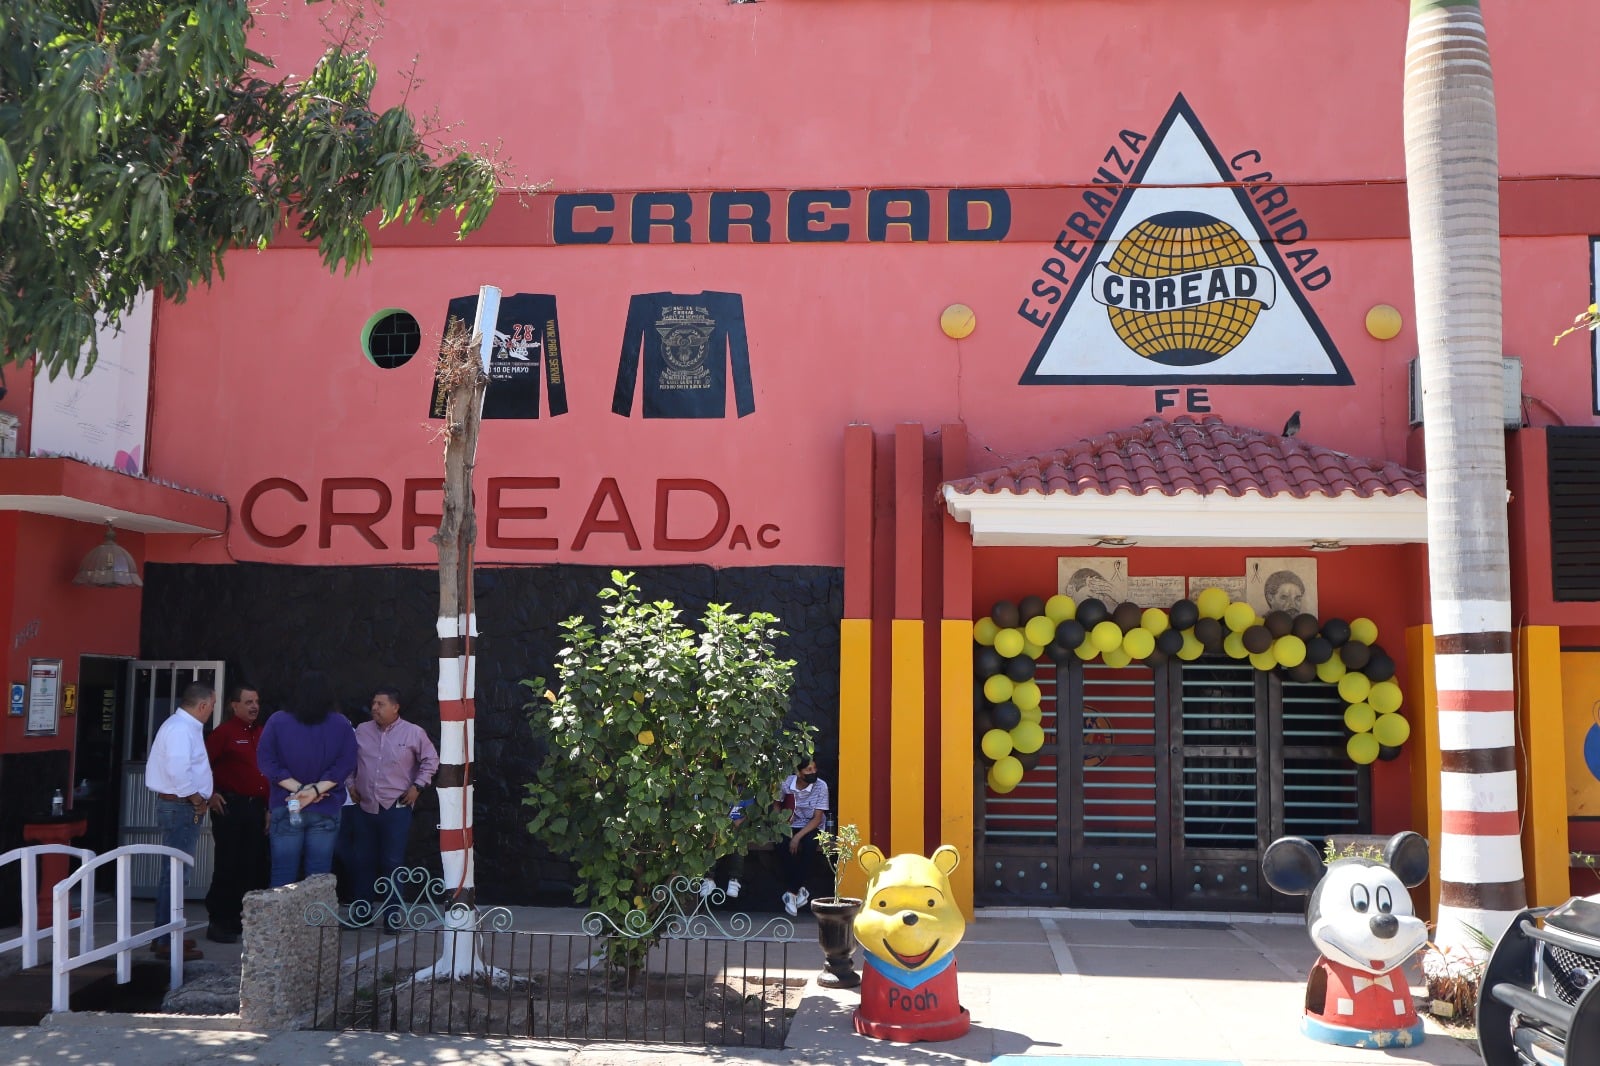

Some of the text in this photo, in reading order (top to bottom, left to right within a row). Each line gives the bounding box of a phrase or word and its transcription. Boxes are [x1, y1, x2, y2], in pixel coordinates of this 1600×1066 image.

[553, 188, 1011, 244] CRREAD
[1017, 129, 1148, 329] ESPERANZA
[1230, 149, 1332, 292] CARIDAD
[1102, 267, 1258, 311] CRREAD
[547, 338, 558, 357] PARA
[549, 359, 560, 384] SERVIR
[1154, 387, 1212, 413] FE
[888, 986, 938, 1012] Pooh
